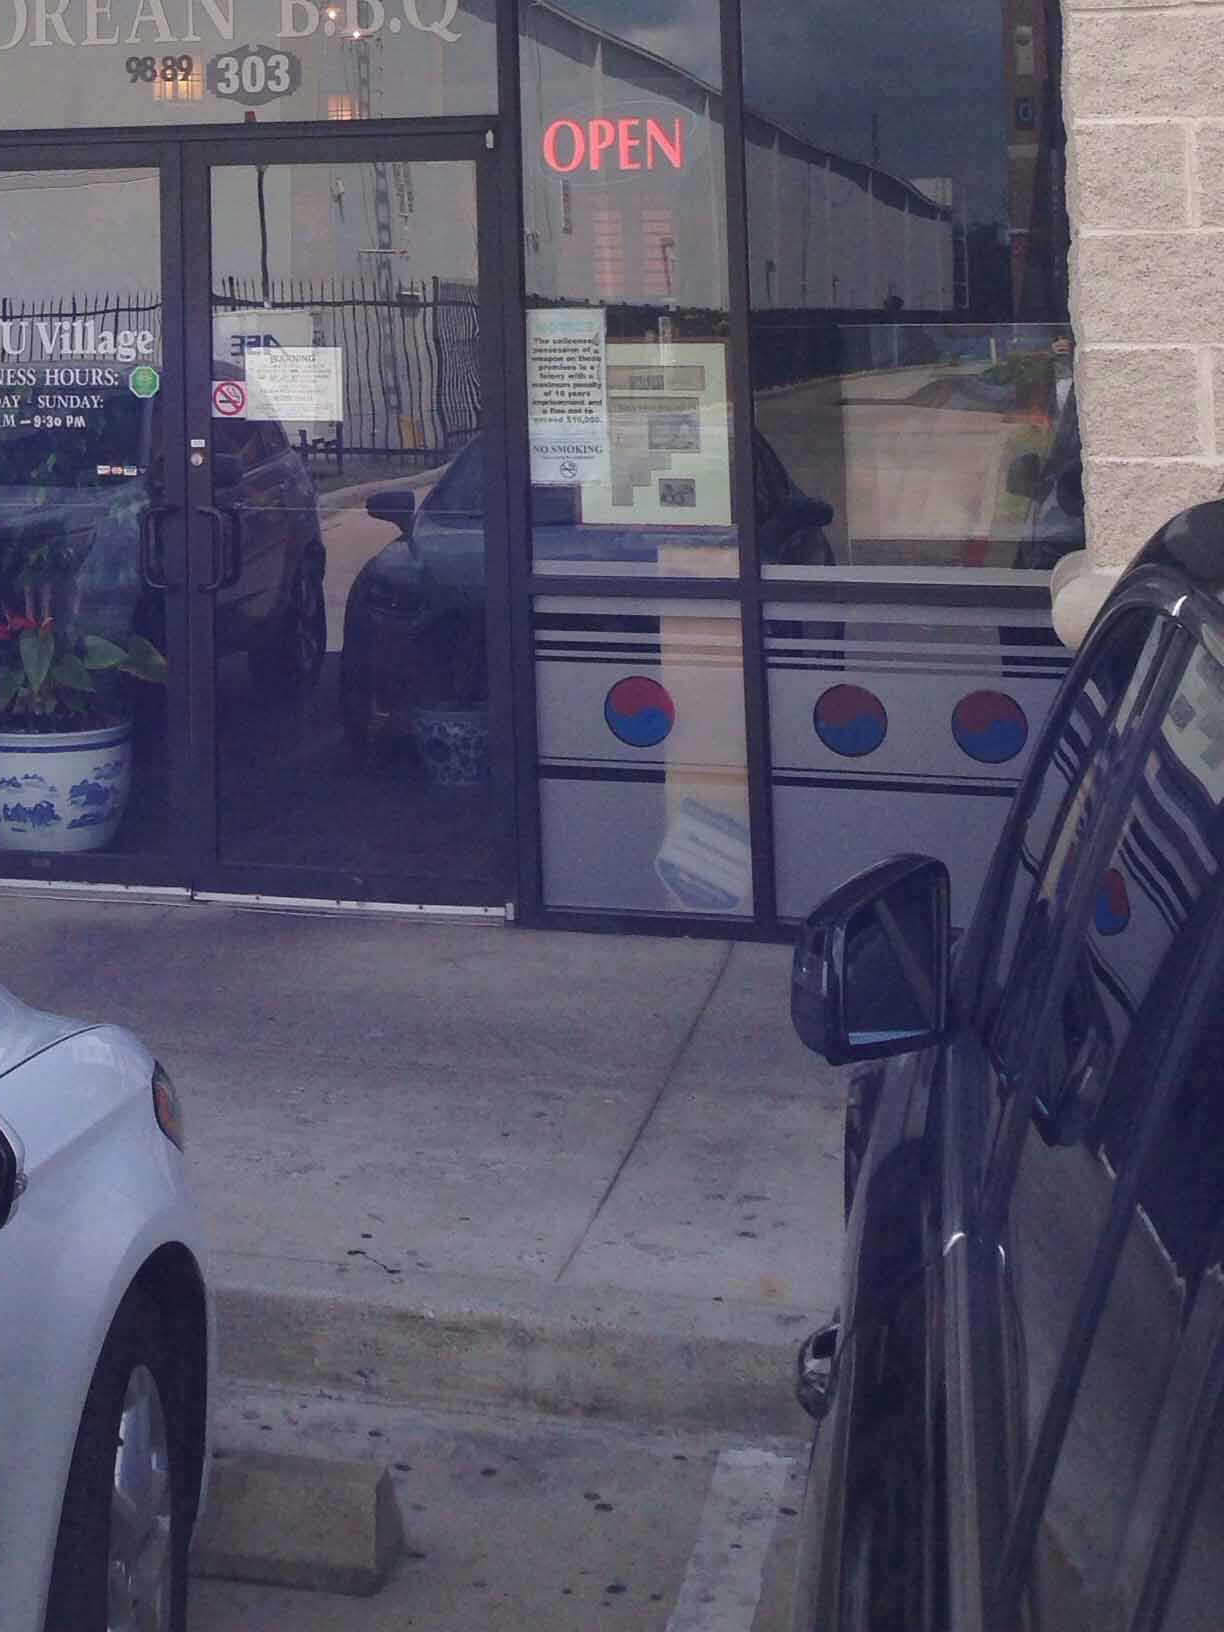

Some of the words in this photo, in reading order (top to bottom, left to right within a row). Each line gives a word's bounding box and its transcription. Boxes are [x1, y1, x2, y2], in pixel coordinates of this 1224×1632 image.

[125, 54, 194, 83] 9889
[216, 54, 291, 95] 303
[542, 117, 684, 173] OPEN
[35, 319, 155, 362] Village
[43, 367, 120, 387] HOURS:
[37, 394, 105, 410] SUNDAY:
[33, 414, 62, 428] 9:30
[65, 414, 87, 428] PM
[551, 444, 604, 454] SMOKING
